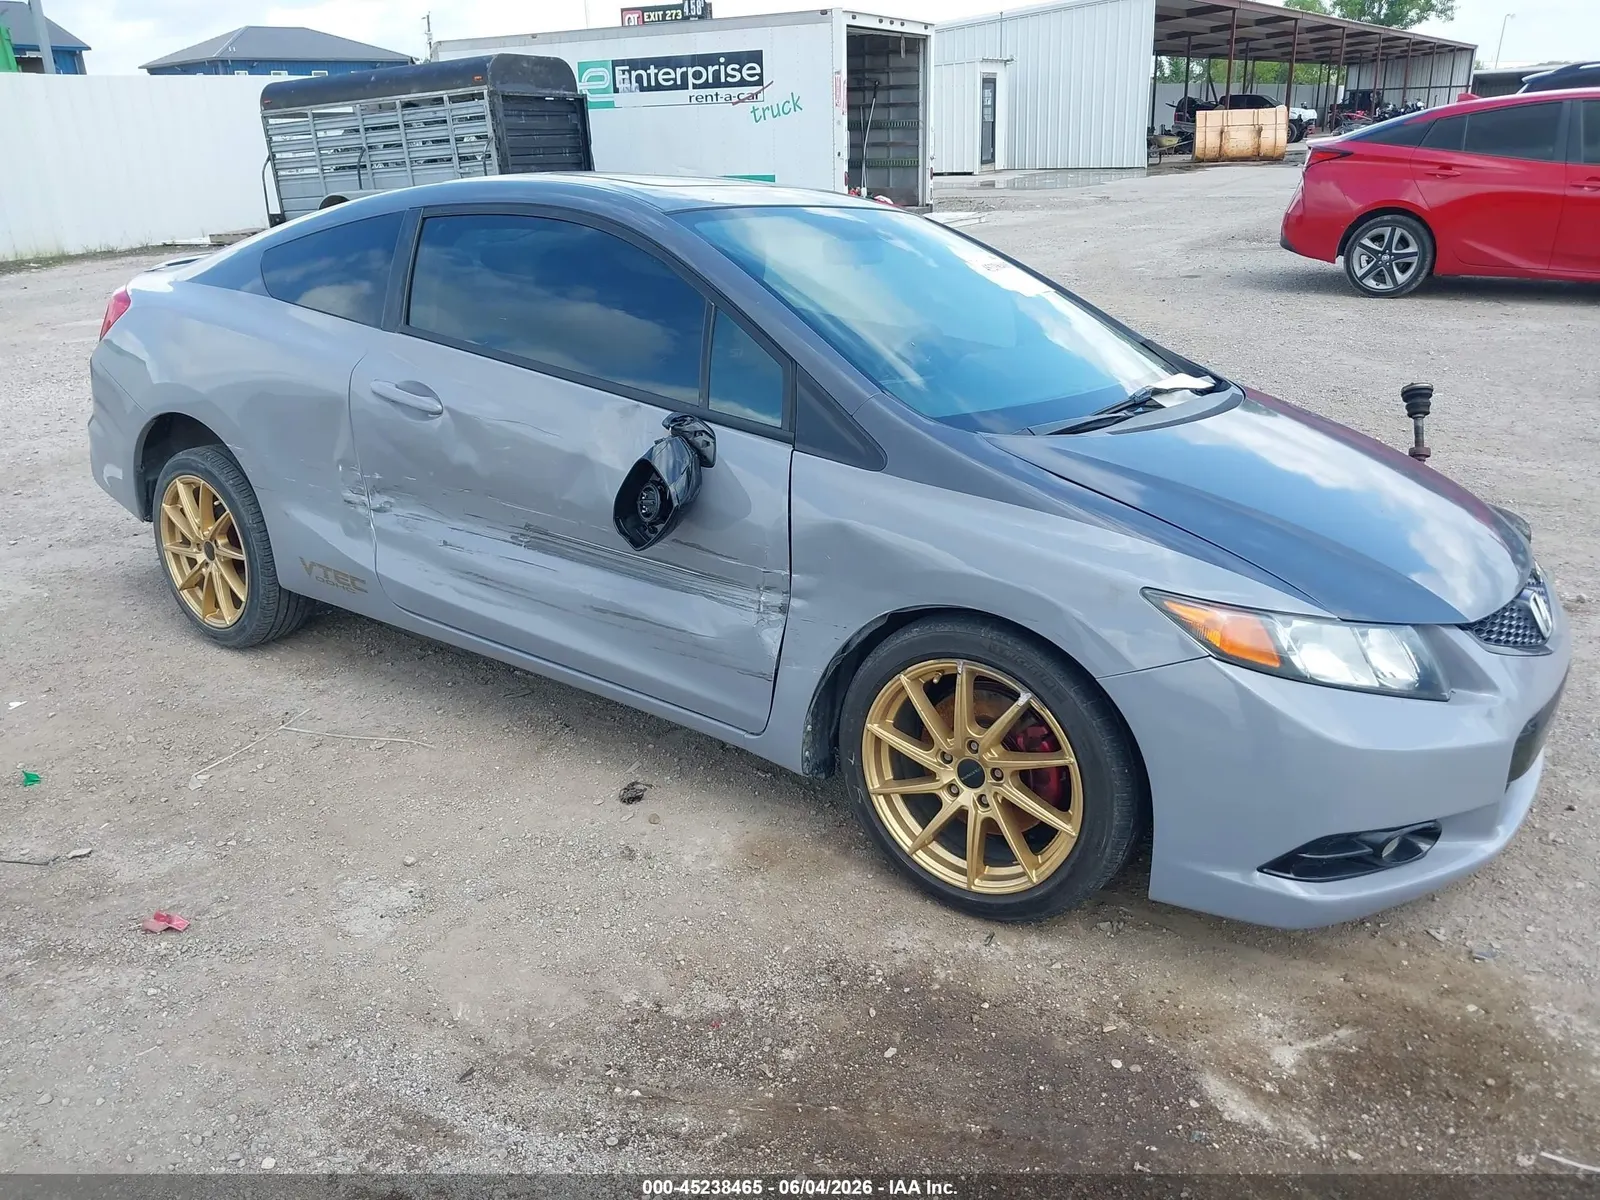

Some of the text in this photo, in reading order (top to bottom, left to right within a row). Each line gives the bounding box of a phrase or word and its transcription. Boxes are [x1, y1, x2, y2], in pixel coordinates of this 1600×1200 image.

[643, 9, 682, 22] EXIT 273
[615, 56, 762, 91] Enterprise
[688, 91, 762, 104] rent-a-car
[750, 92, 803, 124] truck
[299, 556, 368, 594] VTEC
